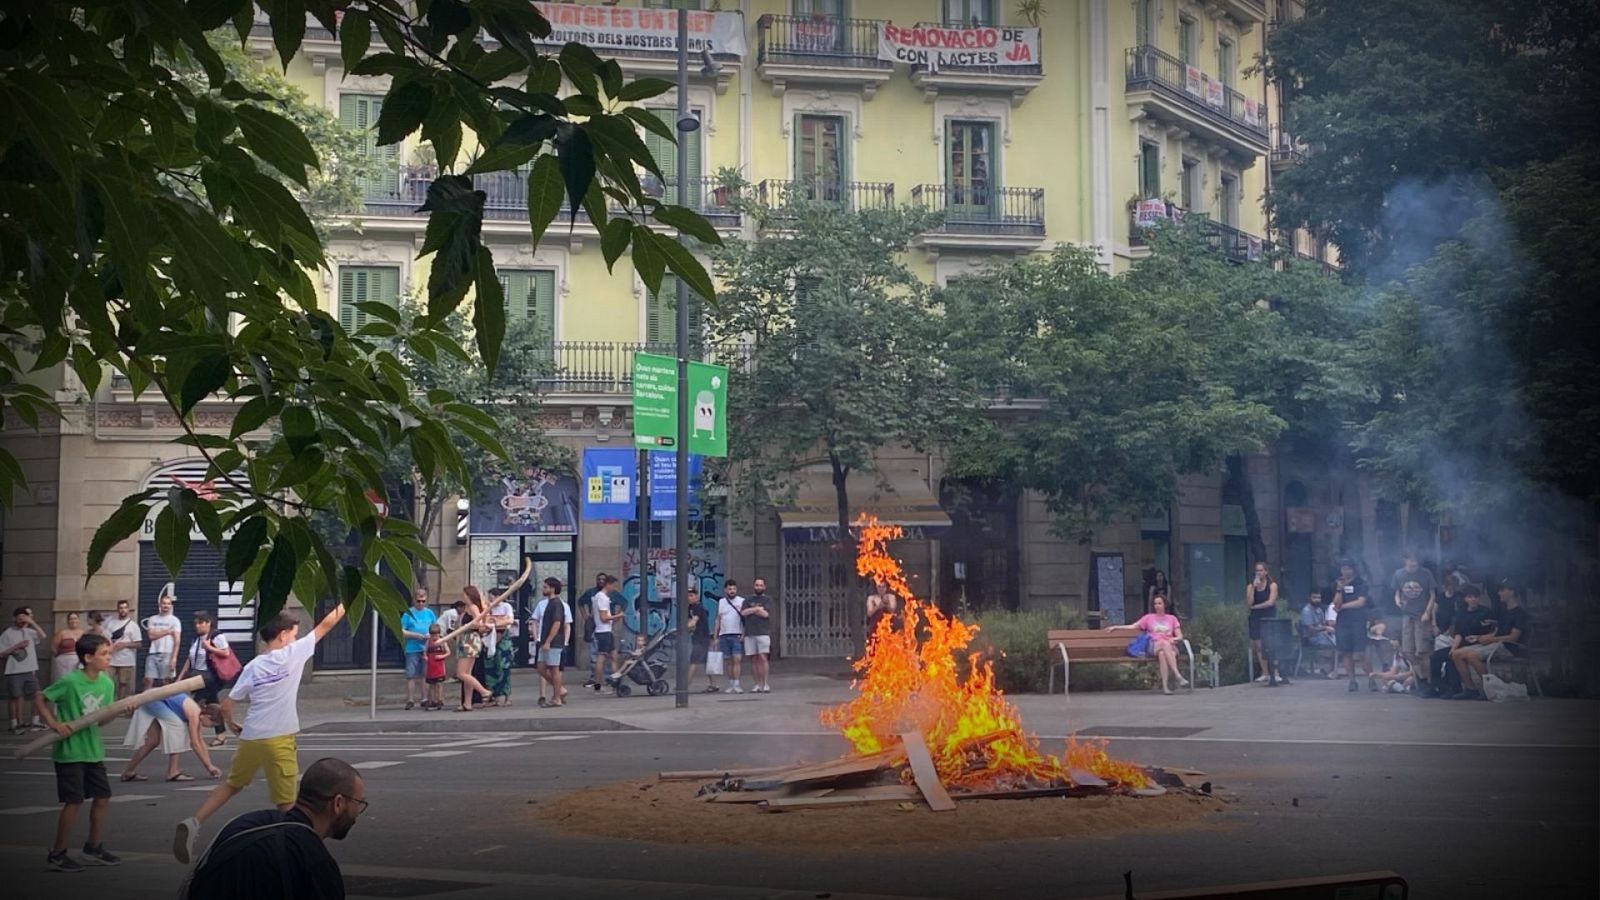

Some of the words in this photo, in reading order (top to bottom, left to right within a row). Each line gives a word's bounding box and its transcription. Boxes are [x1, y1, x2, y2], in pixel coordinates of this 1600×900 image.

[638, 10, 664, 30] UN
[598, 33, 622, 45] DELS
[624, 34, 672, 48] NOSTRES
[1002, 30, 1024, 42] DE
[1005, 44, 1031, 62] JA
